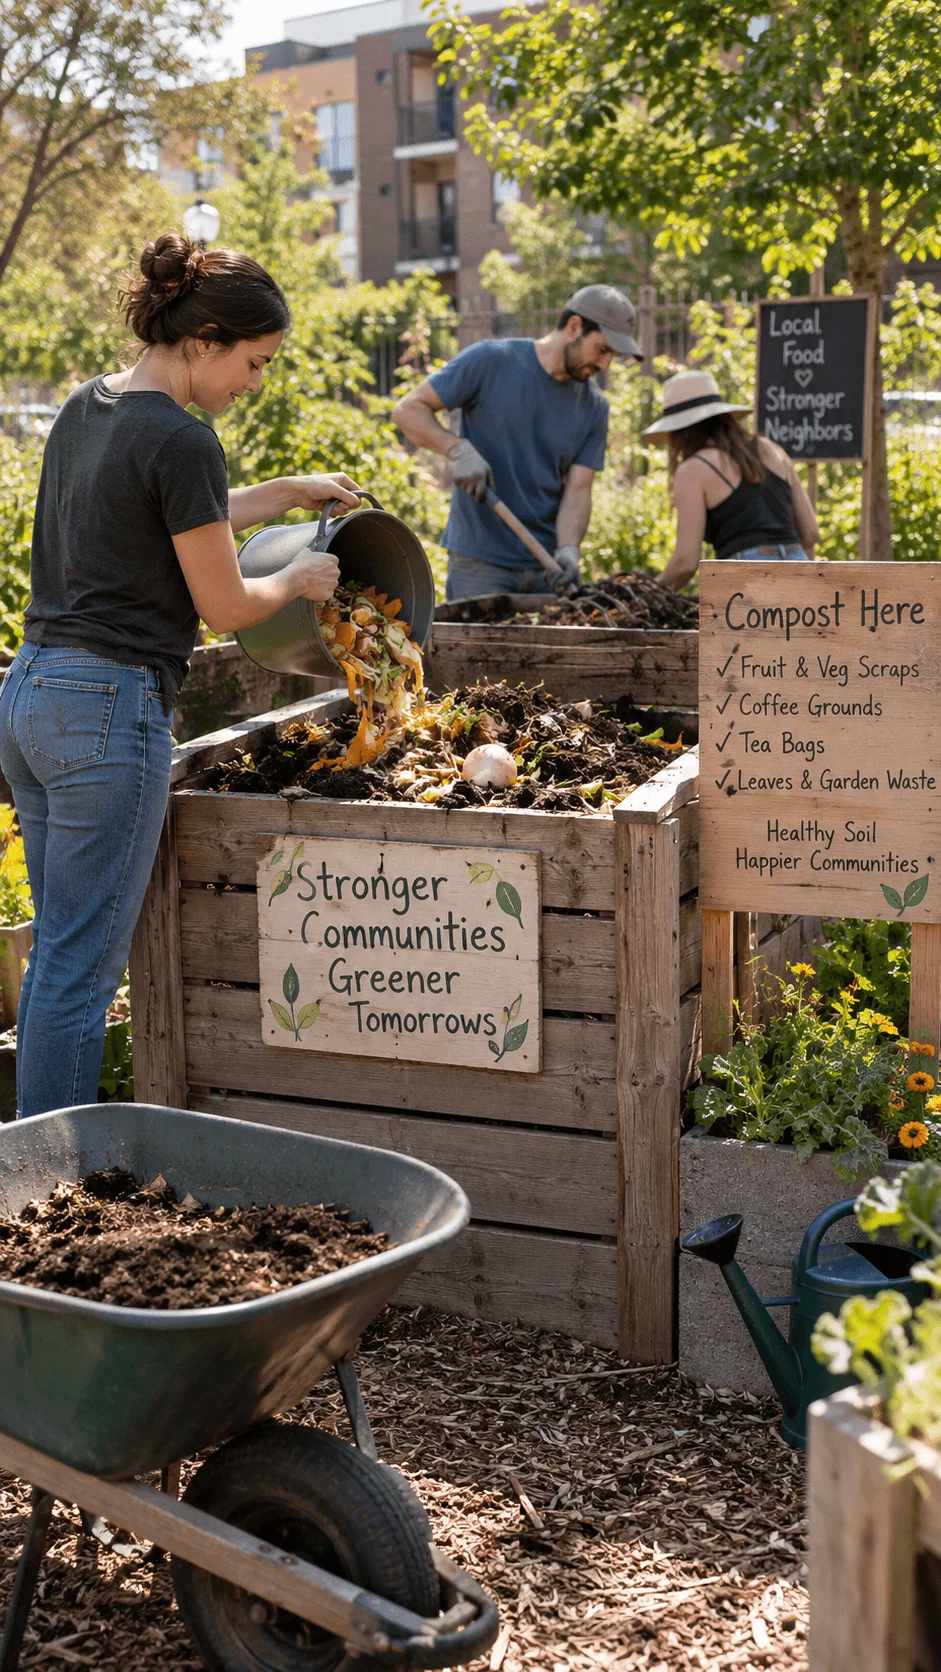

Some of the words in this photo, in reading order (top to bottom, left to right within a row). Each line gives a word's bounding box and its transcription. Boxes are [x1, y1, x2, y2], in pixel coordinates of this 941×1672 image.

[769, 307, 822, 337] Local
[783, 339, 825, 366] Food
[765, 385, 846, 419] Stronger
[764, 416, 853, 452] Neighbors
[725, 591, 845, 641] Compost
[861, 588, 925, 627] Here
[741, 655, 787, 679] Fruit
[796, 655, 808, 678] &
[817, 655, 849, 687] Veg
[858, 655, 920, 686] Scraps
[739, 693, 799, 716] Coffee
[808, 693, 883, 717] Grounds
[739, 730, 771, 753] Tea
[782, 731, 825, 762] Bags
[738, 769, 793, 791] Leaves
[801, 769, 812, 790] &
[820, 769, 879, 790] Garden
[887, 769, 937, 791] Waste
[767, 819, 835, 850] Healthy
[844, 821, 877, 843] Soil
[735, 847, 802, 877] Happier
[810, 849, 919, 874] Communities
[296, 861, 448, 915] Stronger
[301, 911, 506, 952] Communities
[328, 957, 460, 995] Greener
[348, 1000, 498, 1036] Tomorrows
